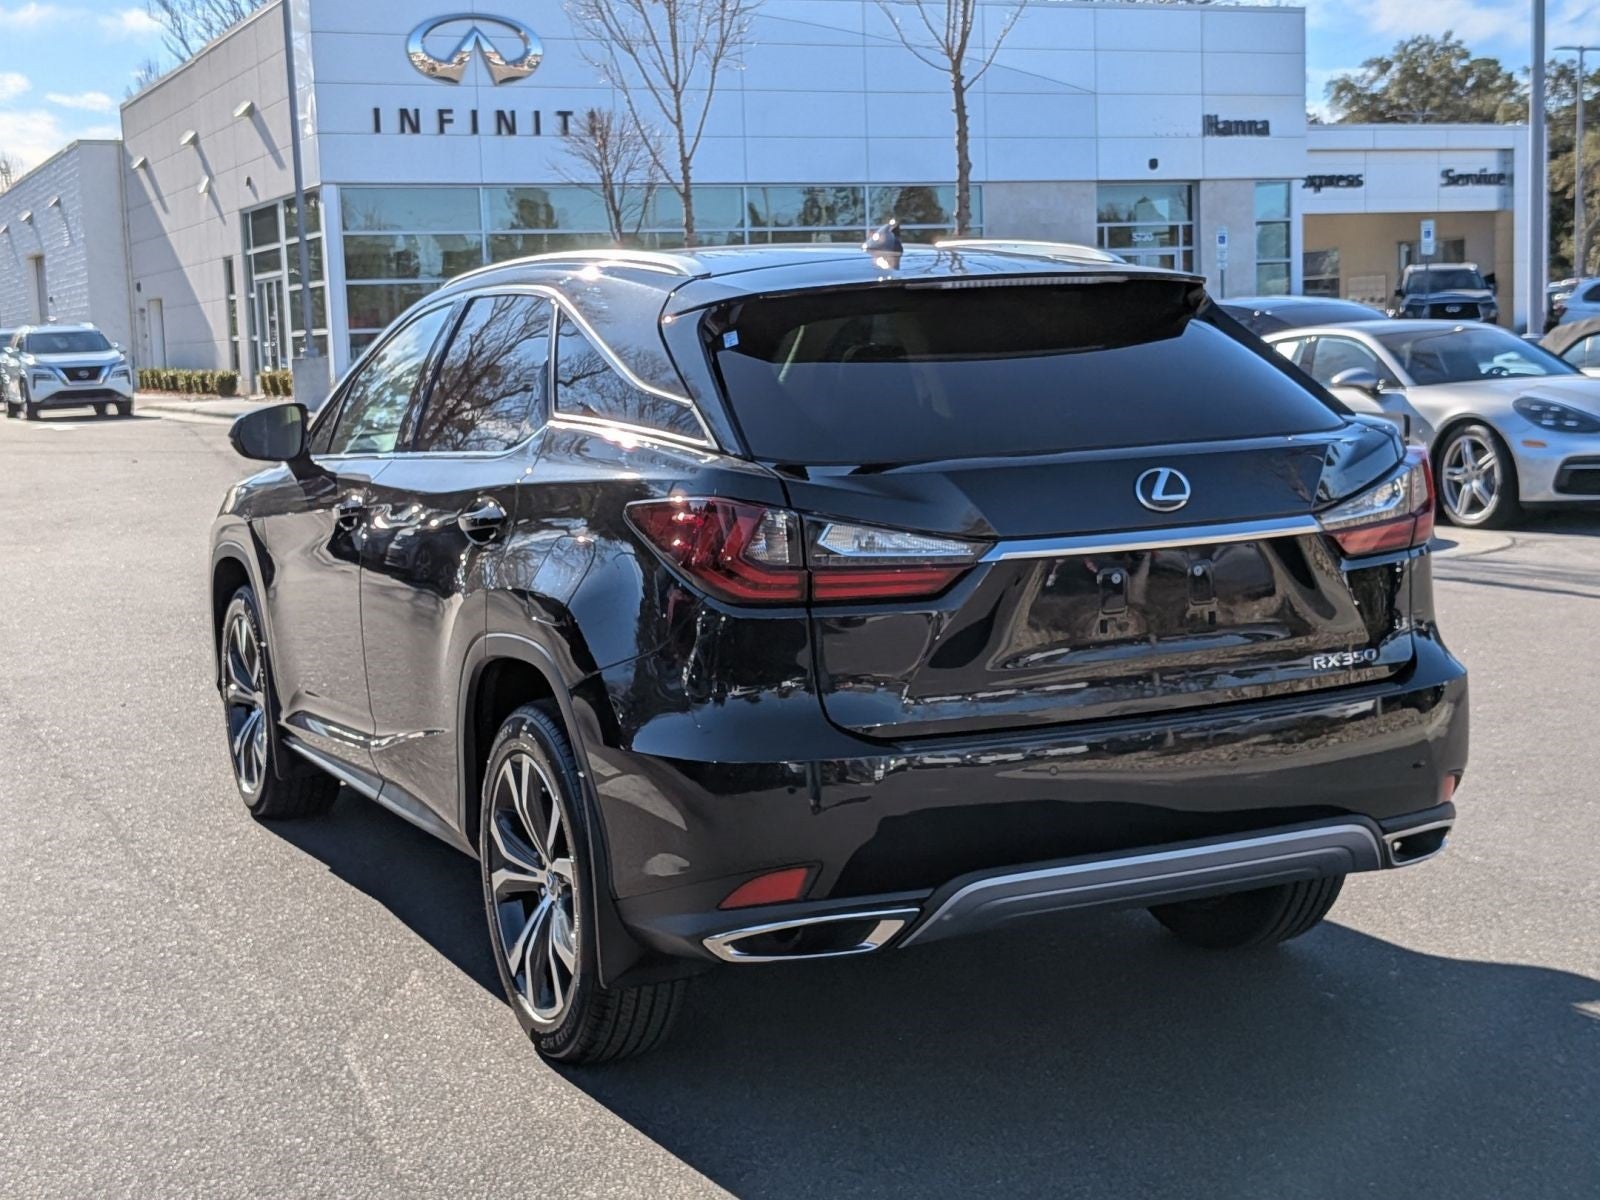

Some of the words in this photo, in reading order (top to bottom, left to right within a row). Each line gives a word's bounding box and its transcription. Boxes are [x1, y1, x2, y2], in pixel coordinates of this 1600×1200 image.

[1203, 114, 1270, 137] Hanna
[1302, 174, 1363, 194] xpress
[1440, 168, 1506, 187] Service
